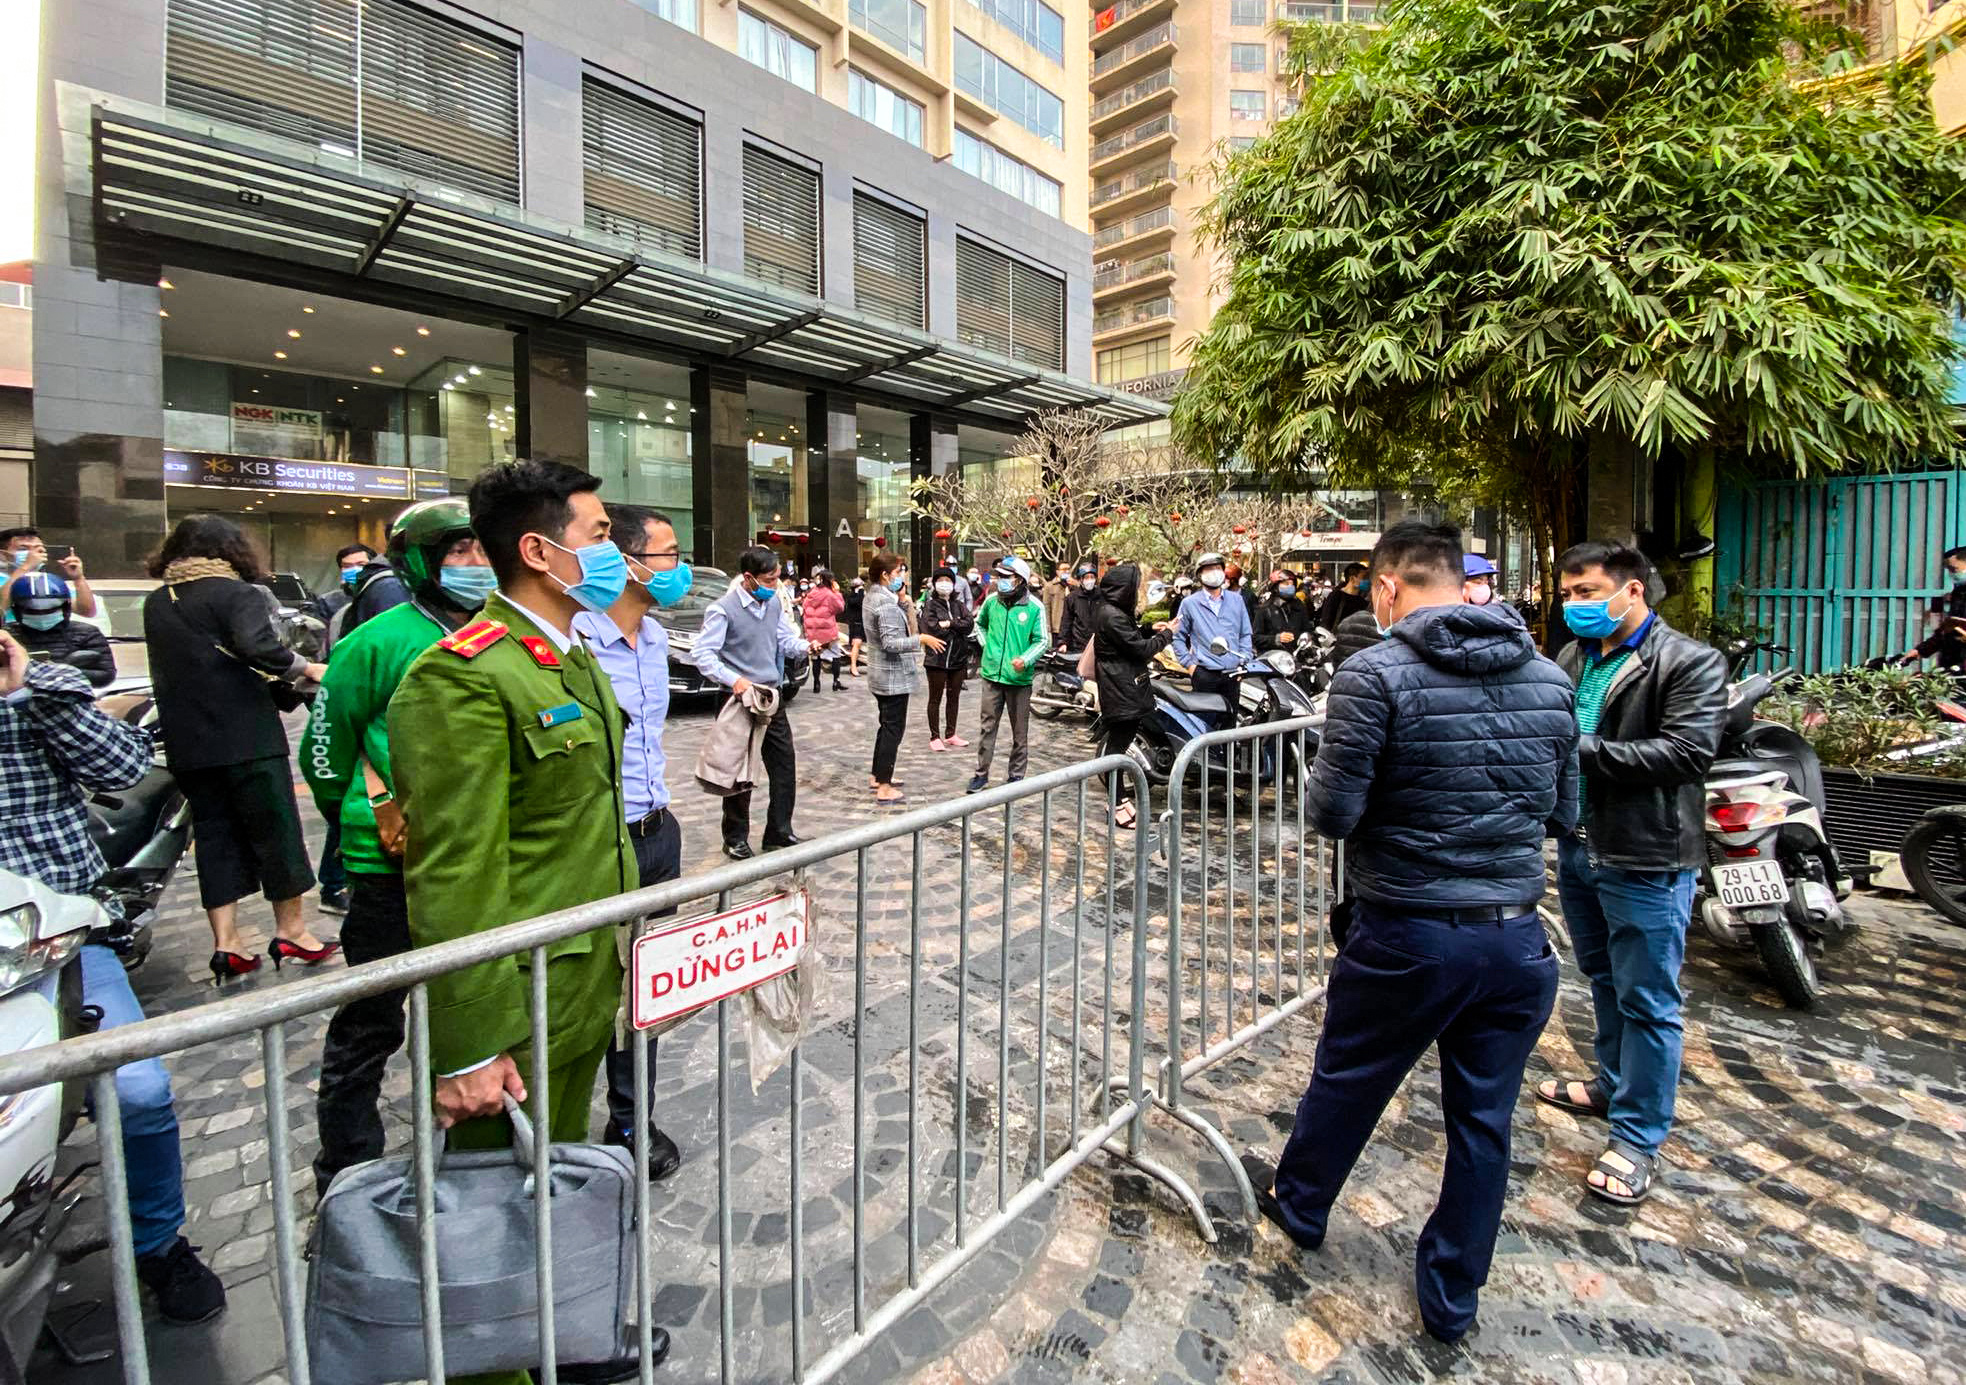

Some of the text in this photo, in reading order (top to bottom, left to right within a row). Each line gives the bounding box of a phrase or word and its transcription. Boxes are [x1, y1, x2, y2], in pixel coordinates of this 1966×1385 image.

[234, 406, 319, 425] NGK NTK
[239, 461, 356, 482] KB Securities
[835, 517, 854, 539] A
[1722, 864, 1770, 886] 29-L1
[1722, 883, 1782, 905] 000.68
[692, 911, 768, 948] C.A.H.N
[651, 925, 798, 1000] DỪNG LẠI
